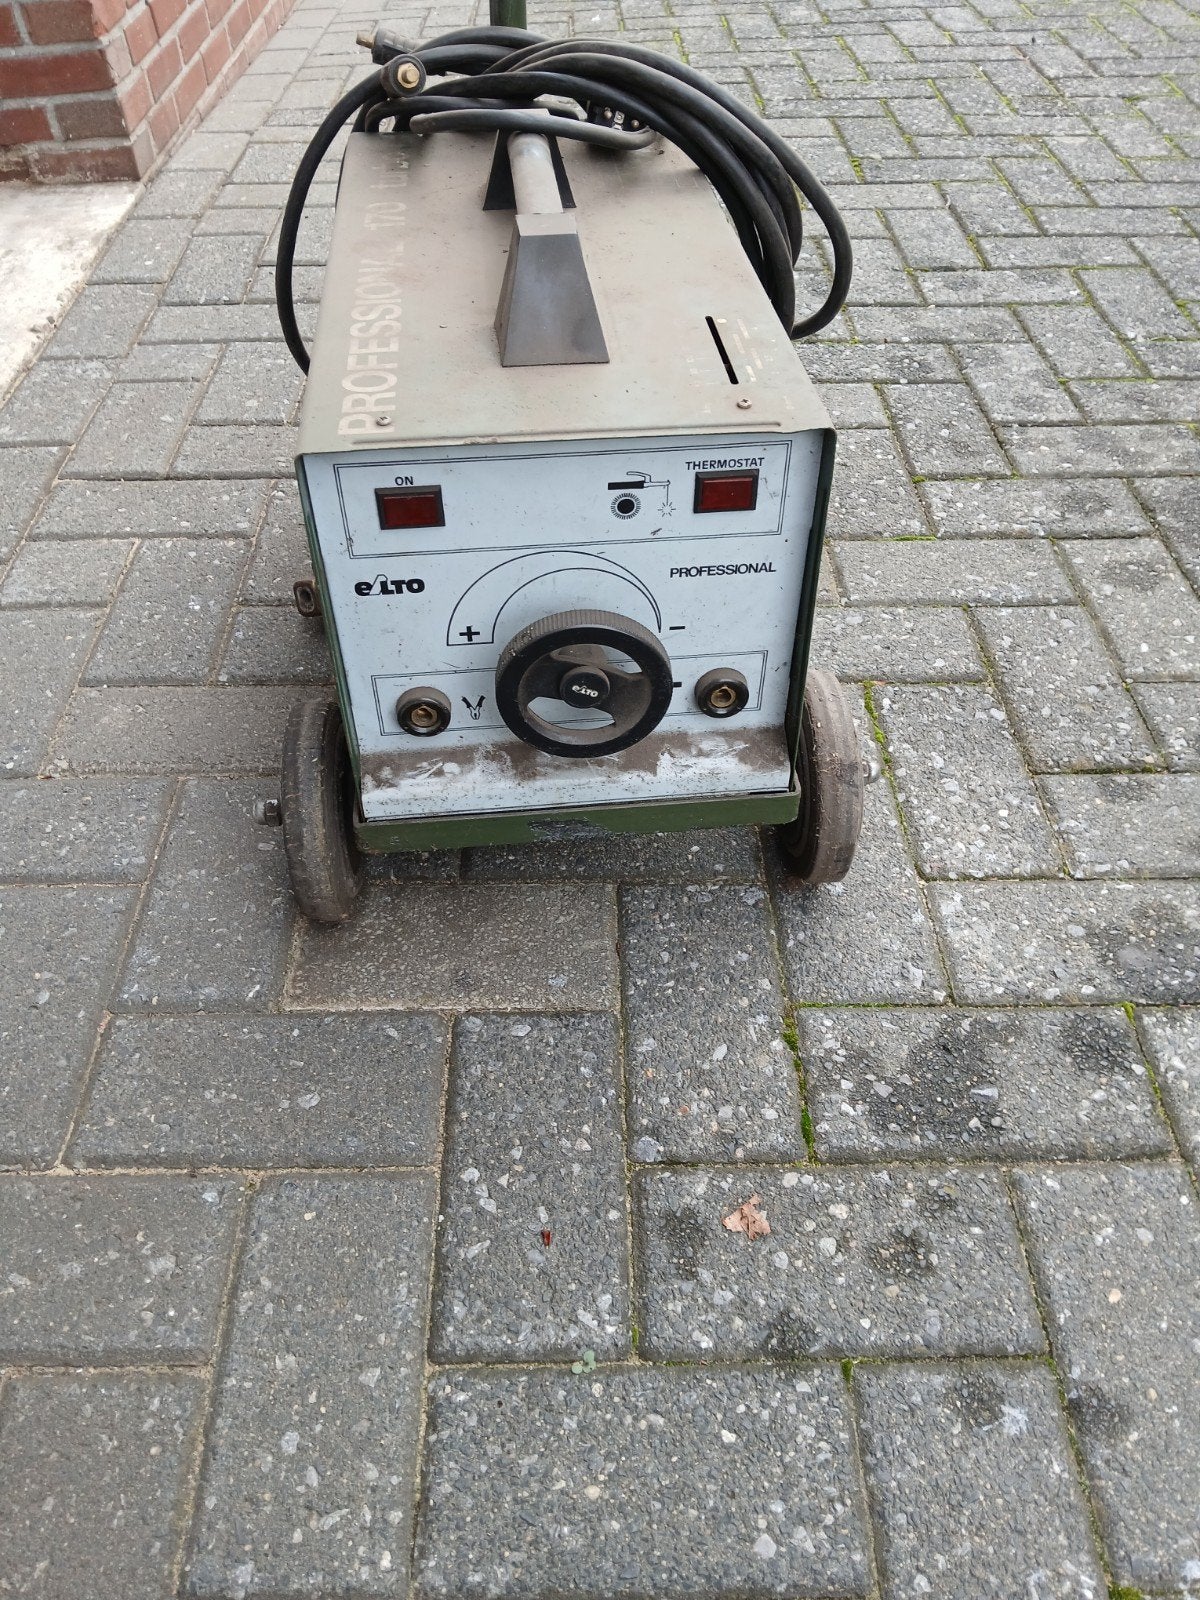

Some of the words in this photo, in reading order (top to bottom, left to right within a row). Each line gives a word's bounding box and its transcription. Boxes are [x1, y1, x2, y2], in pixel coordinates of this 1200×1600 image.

[686, 457, 764, 472] THERMOSTAT
[395, 475, 414, 487] ON
[670, 562, 777, 579] PROFESSIONAL
